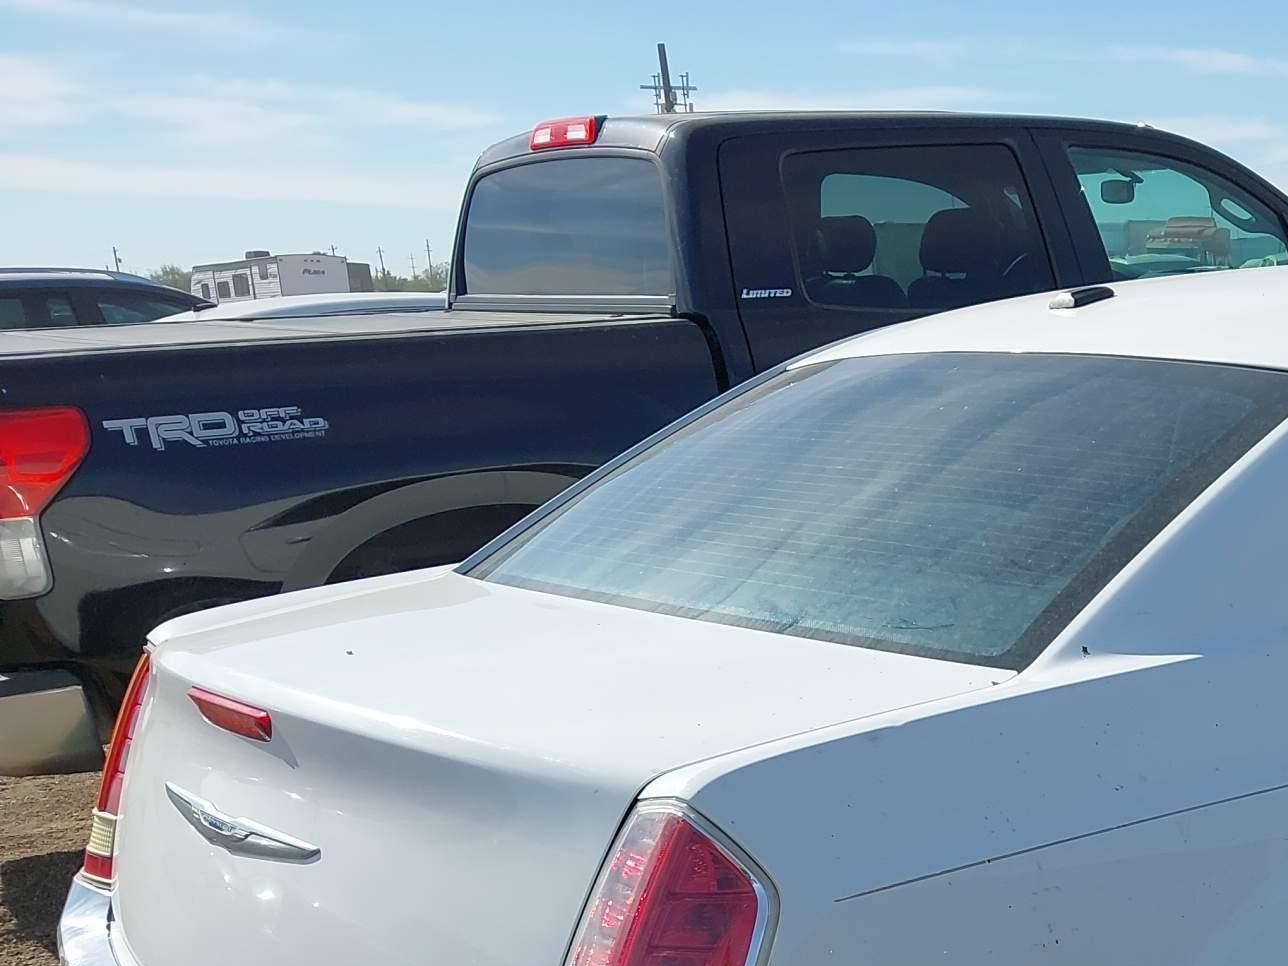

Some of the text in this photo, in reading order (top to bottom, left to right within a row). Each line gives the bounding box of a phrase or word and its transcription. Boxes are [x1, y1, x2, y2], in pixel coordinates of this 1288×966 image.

[741, 288, 793, 299] LIMITED
[102, 411, 240, 451] TRD
[241, 417, 329, 437] ROAD
[208, 430, 326, 448] TOYOTA RACING DEVELOPMENT
